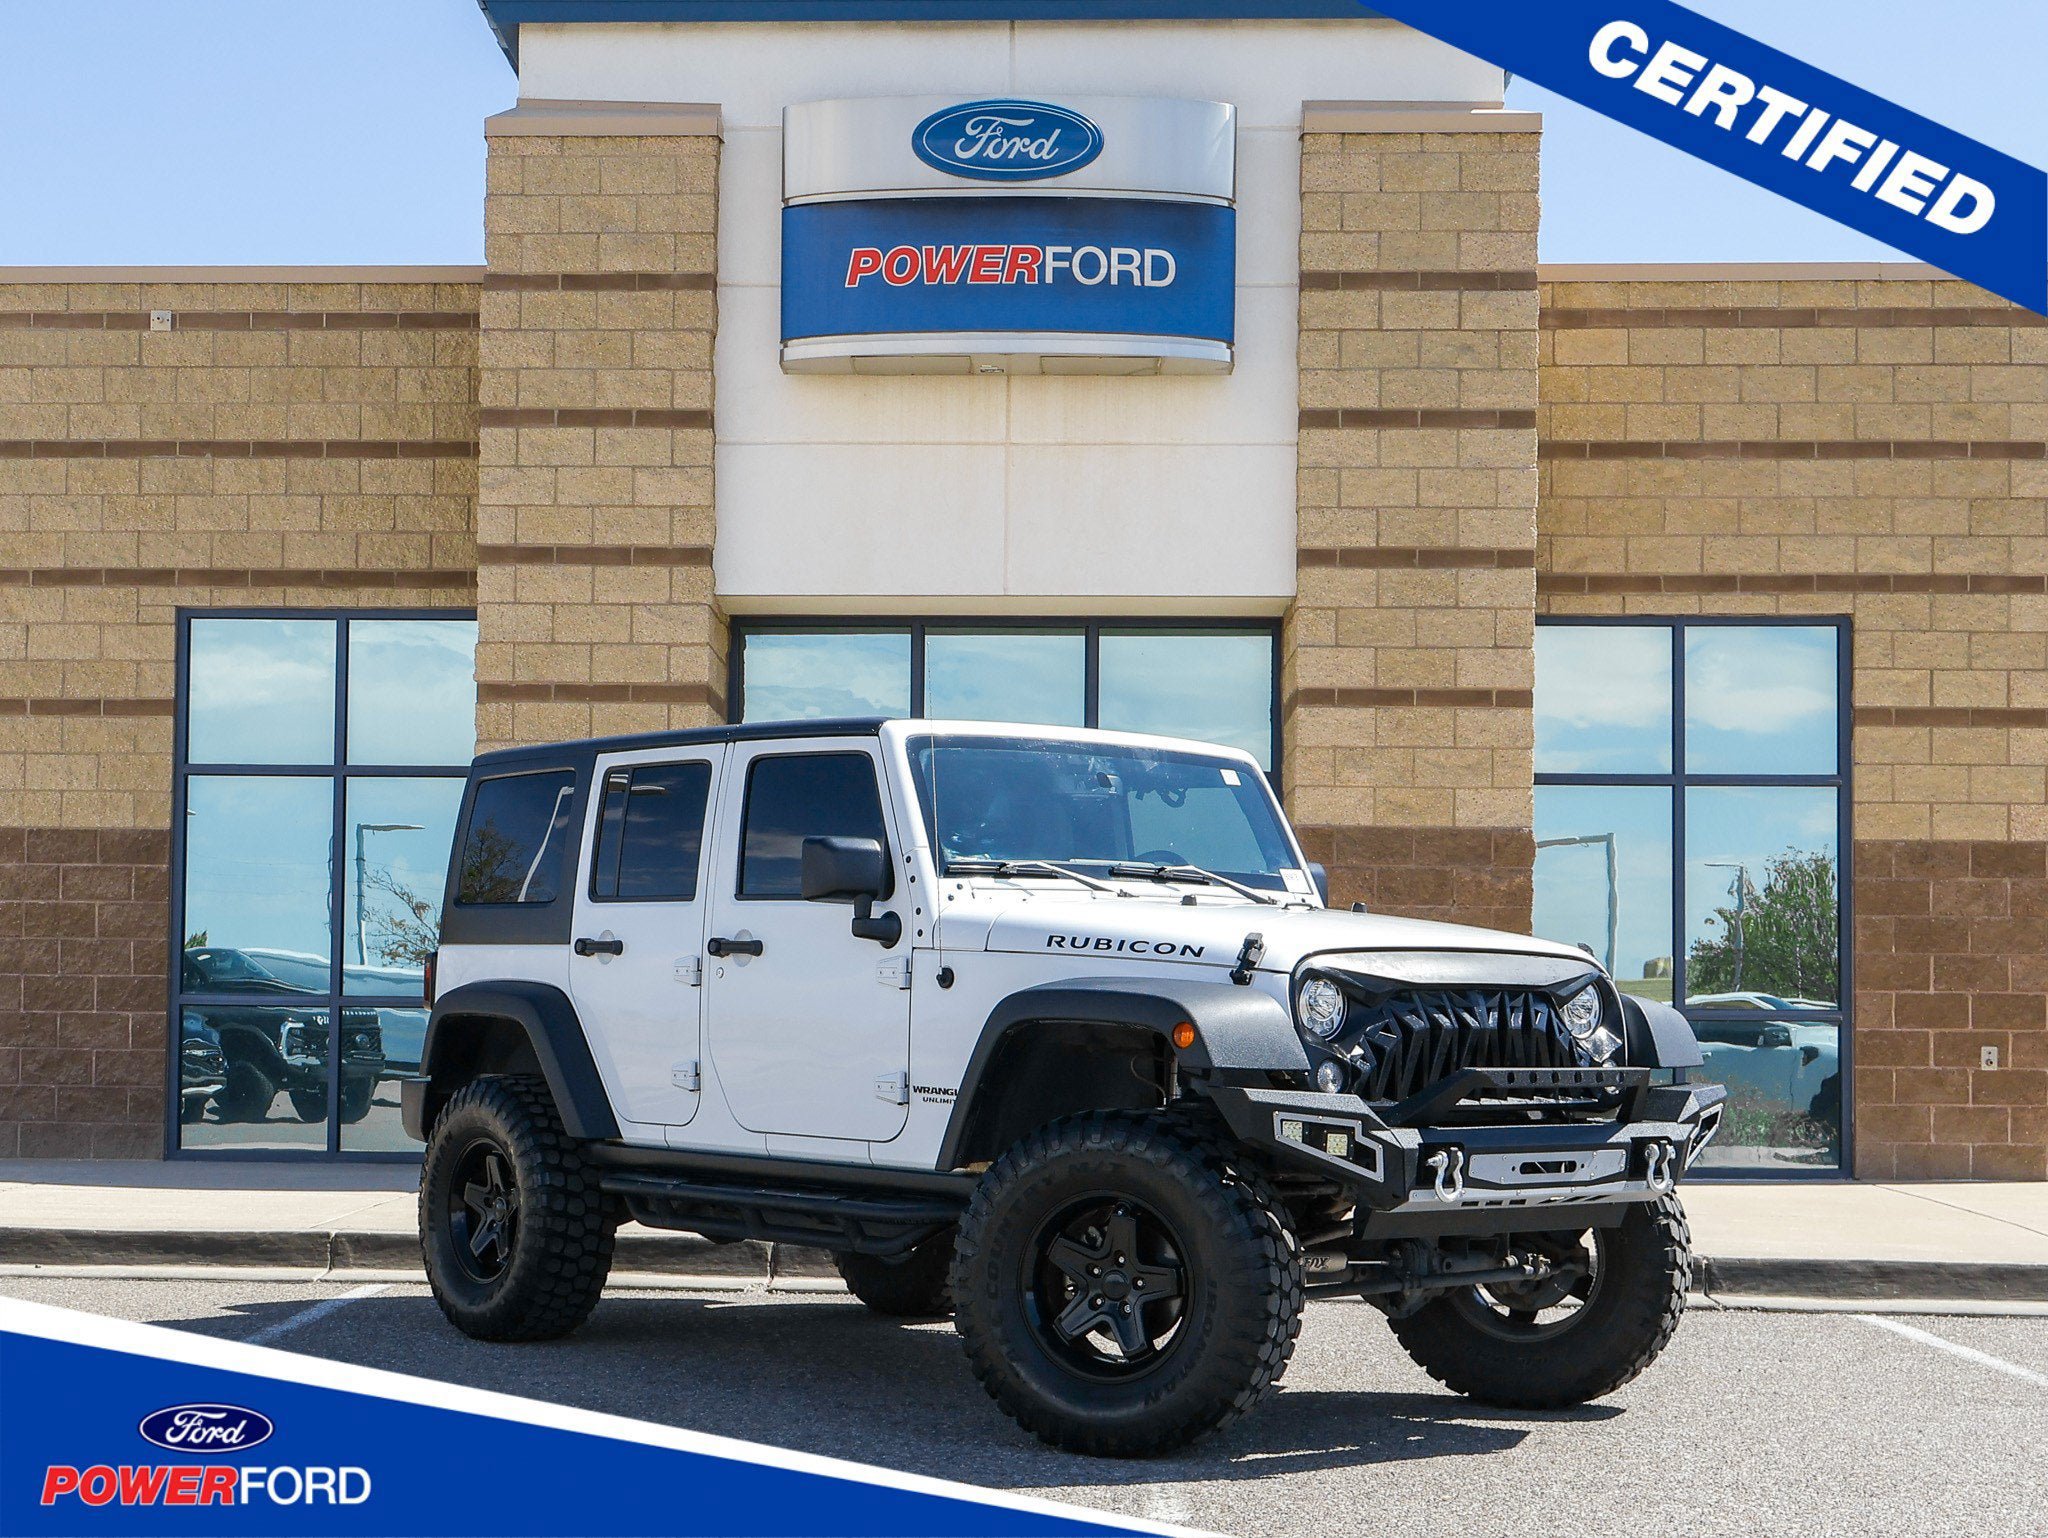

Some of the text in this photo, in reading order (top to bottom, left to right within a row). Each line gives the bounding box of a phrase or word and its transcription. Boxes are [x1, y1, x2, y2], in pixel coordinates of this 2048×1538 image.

[954, 115, 1061, 161] Ford
[845, 244, 1177, 288] POWERFORD
[1046, 934, 1206, 958] RUBICON
[912, 1085, 958, 1097] WRANGL
[922, 1096, 954, 1105] UNLIMI
[1303, 1256, 1330, 1269] FOX
